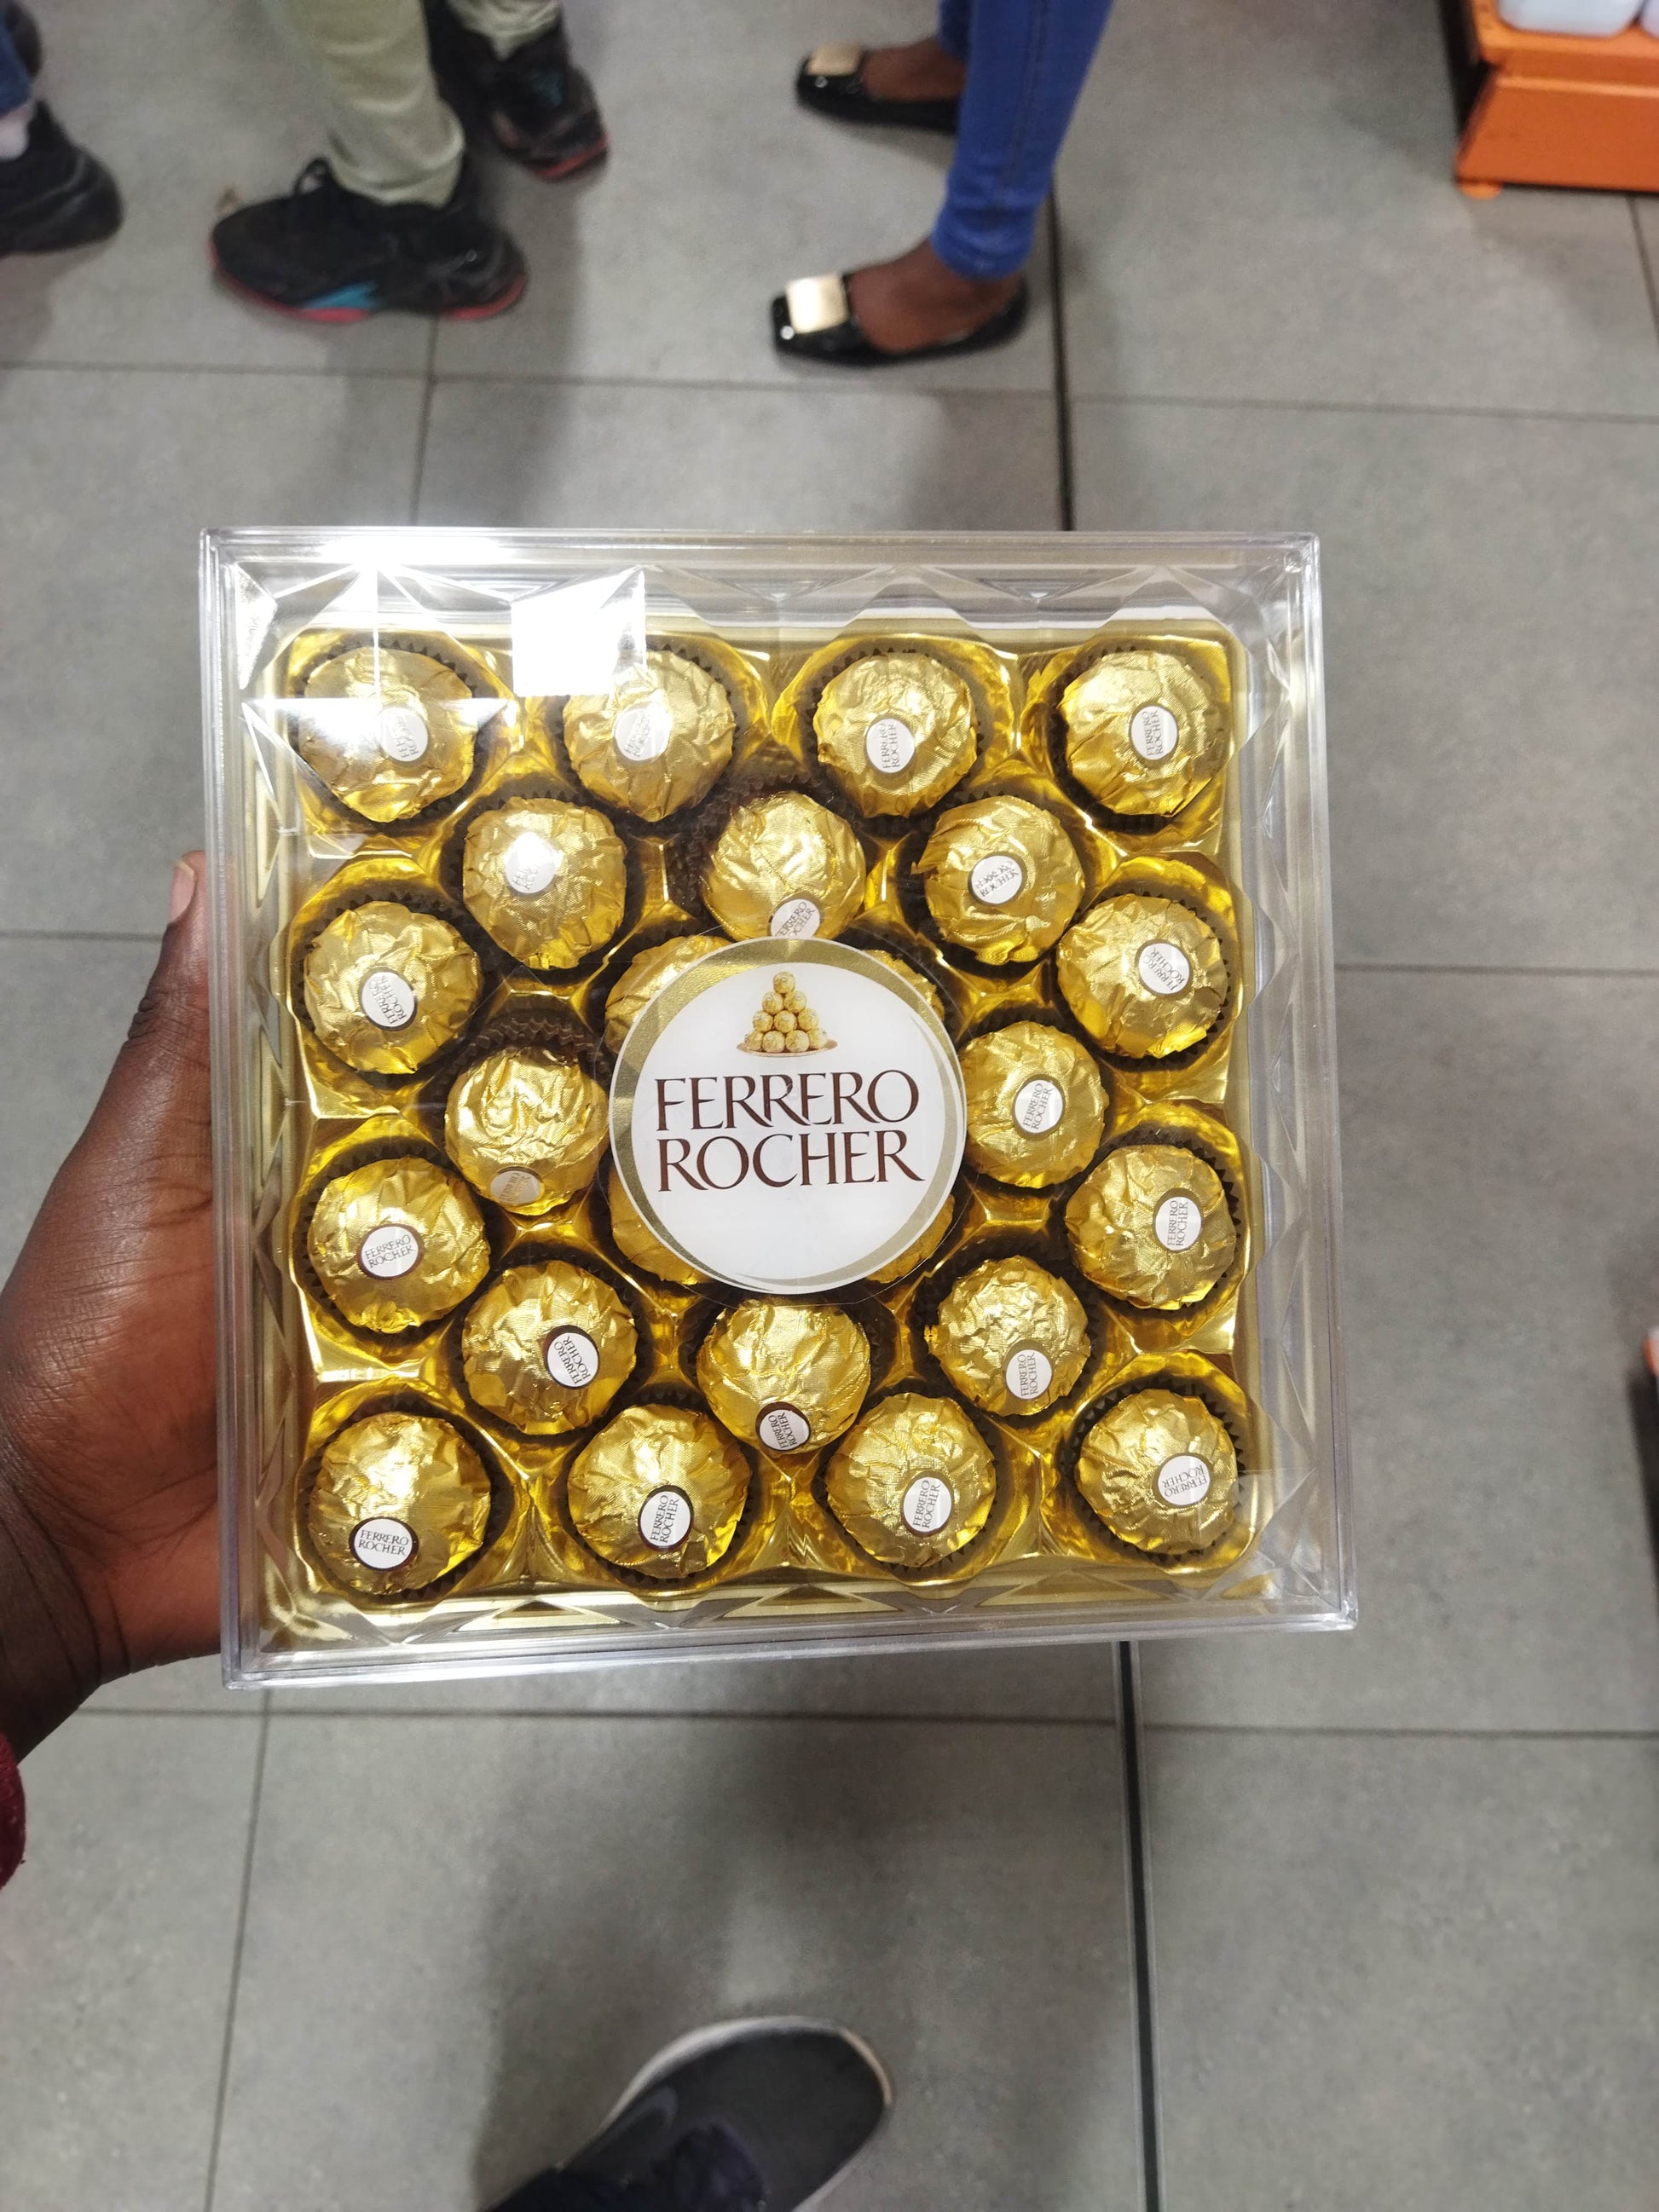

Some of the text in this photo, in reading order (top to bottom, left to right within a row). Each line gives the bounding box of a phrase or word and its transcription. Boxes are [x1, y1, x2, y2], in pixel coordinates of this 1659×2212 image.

[655, 1070, 919, 1131] FERRERO
[1023, 1083, 1043, 1127] FERRERO
[1032, 1088, 1053, 1129] ROCHER
[656, 1129, 926, 1193] ROCHER
[1167, 1200, 1178, 1245] FERRERO
[1176, 1202, 1188, 1245] ROCHER
[365, 1235, 411, 1260] FERRERO
[368, 1245, 414, 1268] ROCHER
[554, 1341, 582, 1384] FERRERO
[563, 1336, 591, 1380] ROCHER
[1017, 1354, 1028, 1396] FERRERO
[1027, 1353, 1038, 1395] ROCHER
[768, 1415, 789, 1448] FERRERO
[778, 1412, 797, 1446] ROCHER
[1162, 1464, 1204, 1487] ROCHER
[1165, 1476, 1207, 1497] FERRERO
[650, 1495, 668, 1540] FERRERO
[660, 1499, 679, 1542] ROCHER
[913, 1481, 930, 1527] FERRERO
[922, 1484, 940, 1528] ROCHER
[358, 1539, 405, 1556] ROCHER
[361, 1530, 408, 1545] FERRERO
